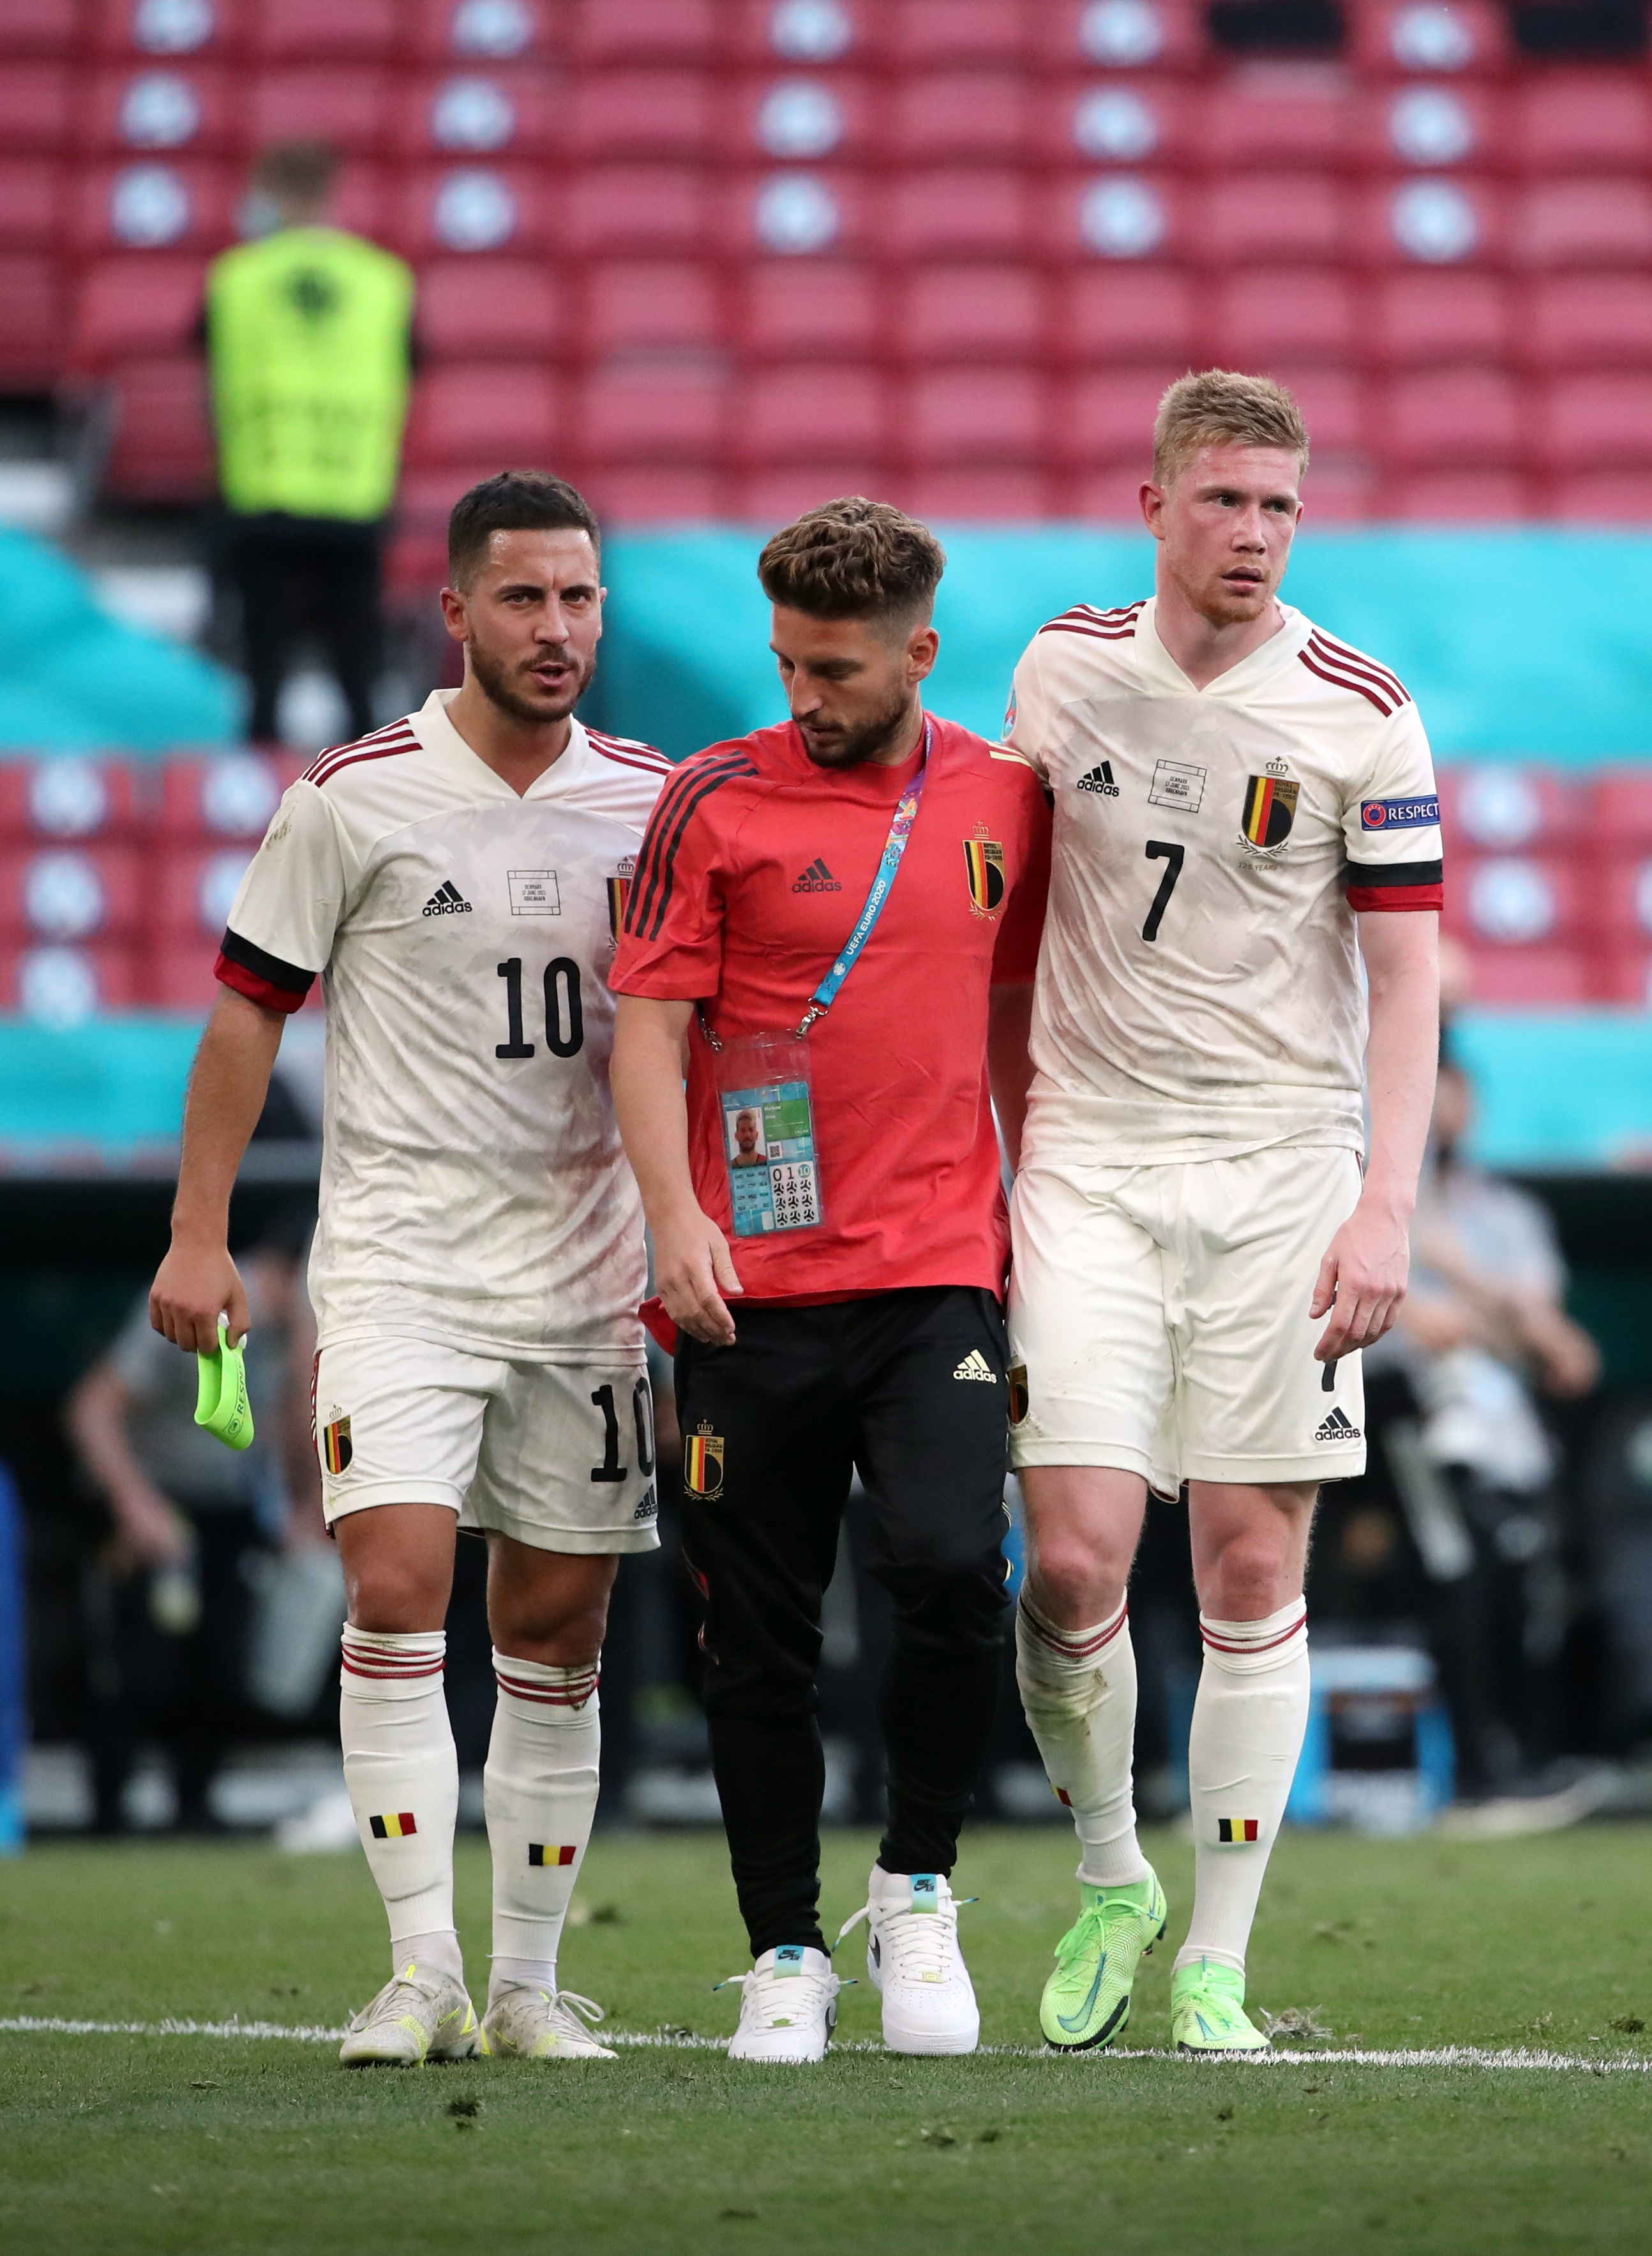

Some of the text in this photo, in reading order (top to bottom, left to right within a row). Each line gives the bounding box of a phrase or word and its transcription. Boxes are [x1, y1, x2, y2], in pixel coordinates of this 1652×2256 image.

[1077, 779, 1120, 797] adidas
[1388, 802, 1439, 820] RESPECT
[792, 880, 841, 893] adidas
[1142, 839, 1185, 942] 7
[422, 901, 472, 917] adidas
[846, 880, 887, 956] UEFA EURO 2020
[495, 956, 583, 1058] 10
[952, 1369, 997, 1384] adidas
[590, 1377, 655, 1482] 10
[1315, 1428, 1361, 1441] adidas
